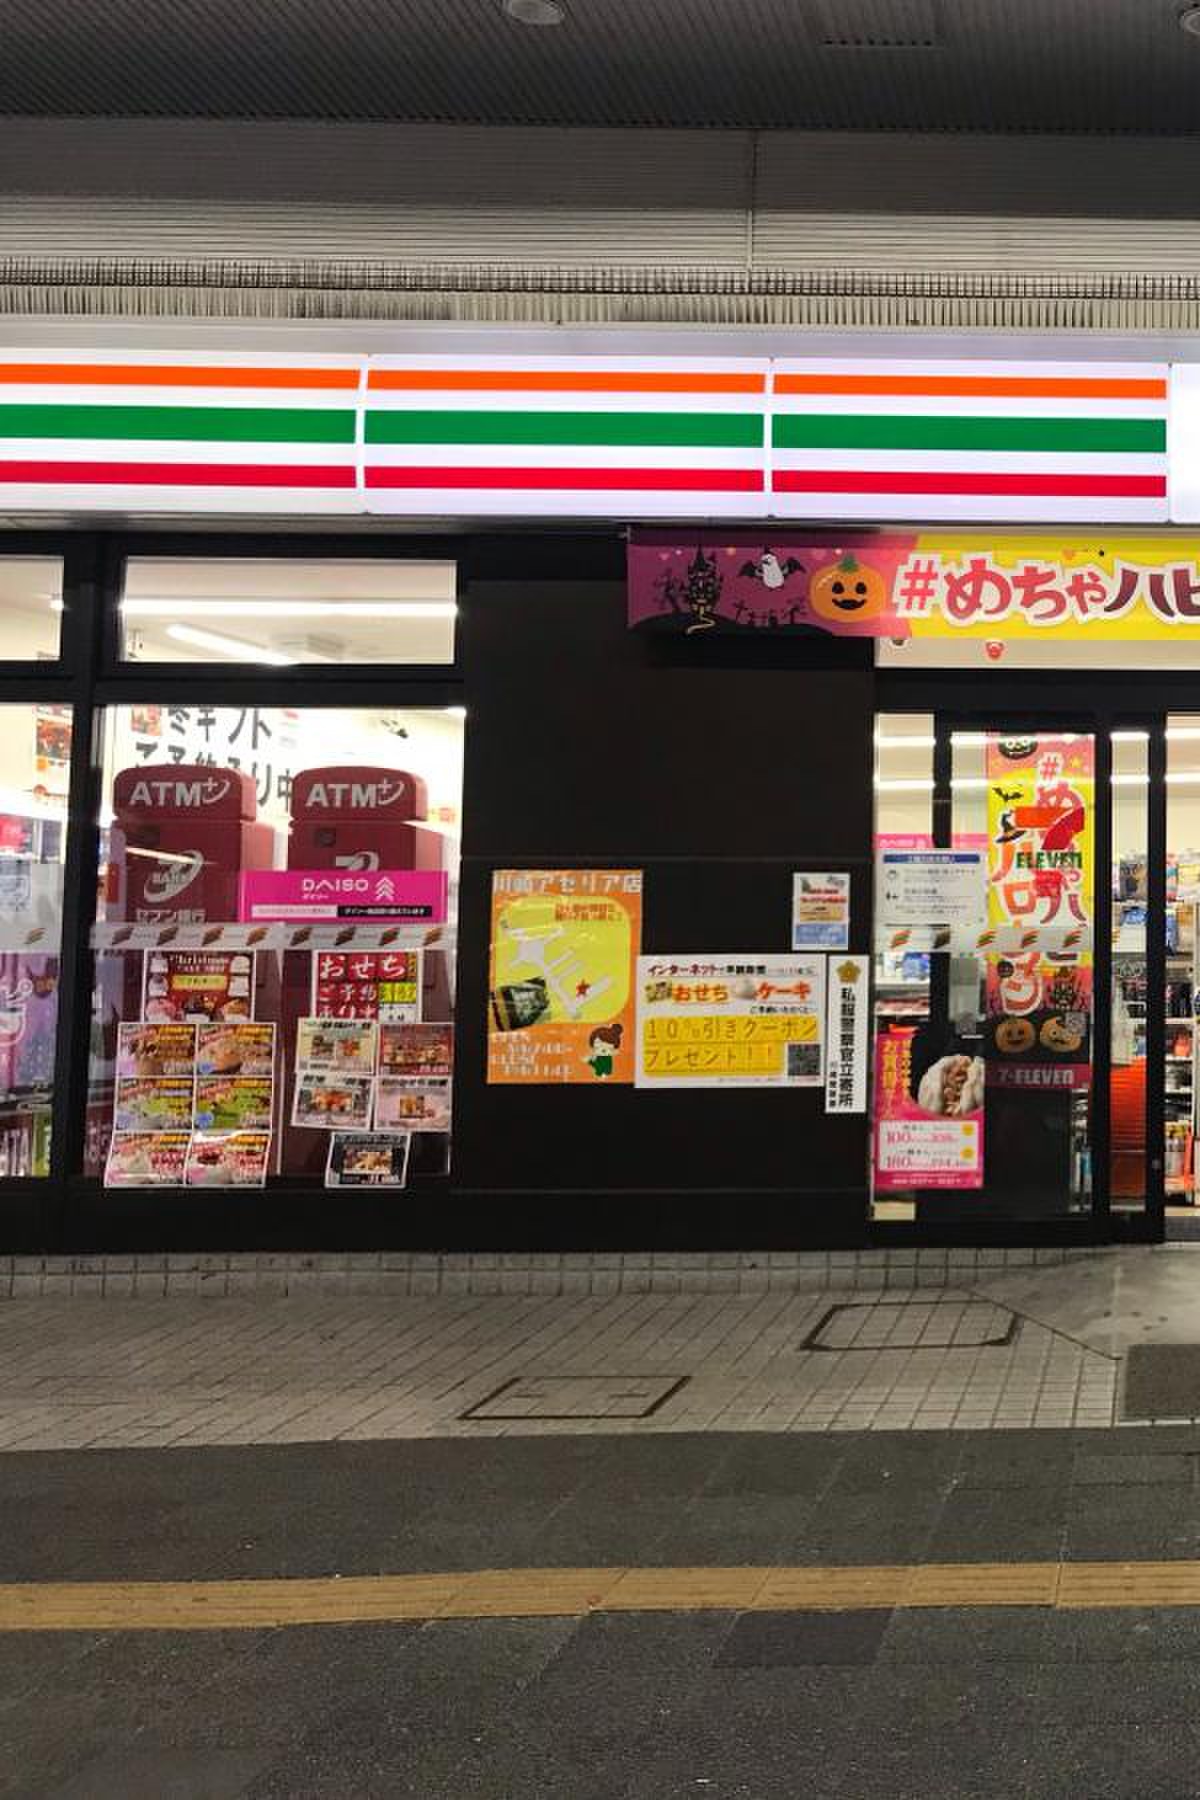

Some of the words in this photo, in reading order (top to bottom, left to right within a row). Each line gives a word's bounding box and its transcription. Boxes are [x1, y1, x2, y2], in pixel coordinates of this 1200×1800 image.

[129, 781, 201, 807] ATM
[305, 783, 378, 808] ATM
[302, 879, 369, 892] DAISO
[319, 954, 406, 979] おせち
[672, 983, 729, 1002] おせち
[757, 981, 811, 999] ケーキ
